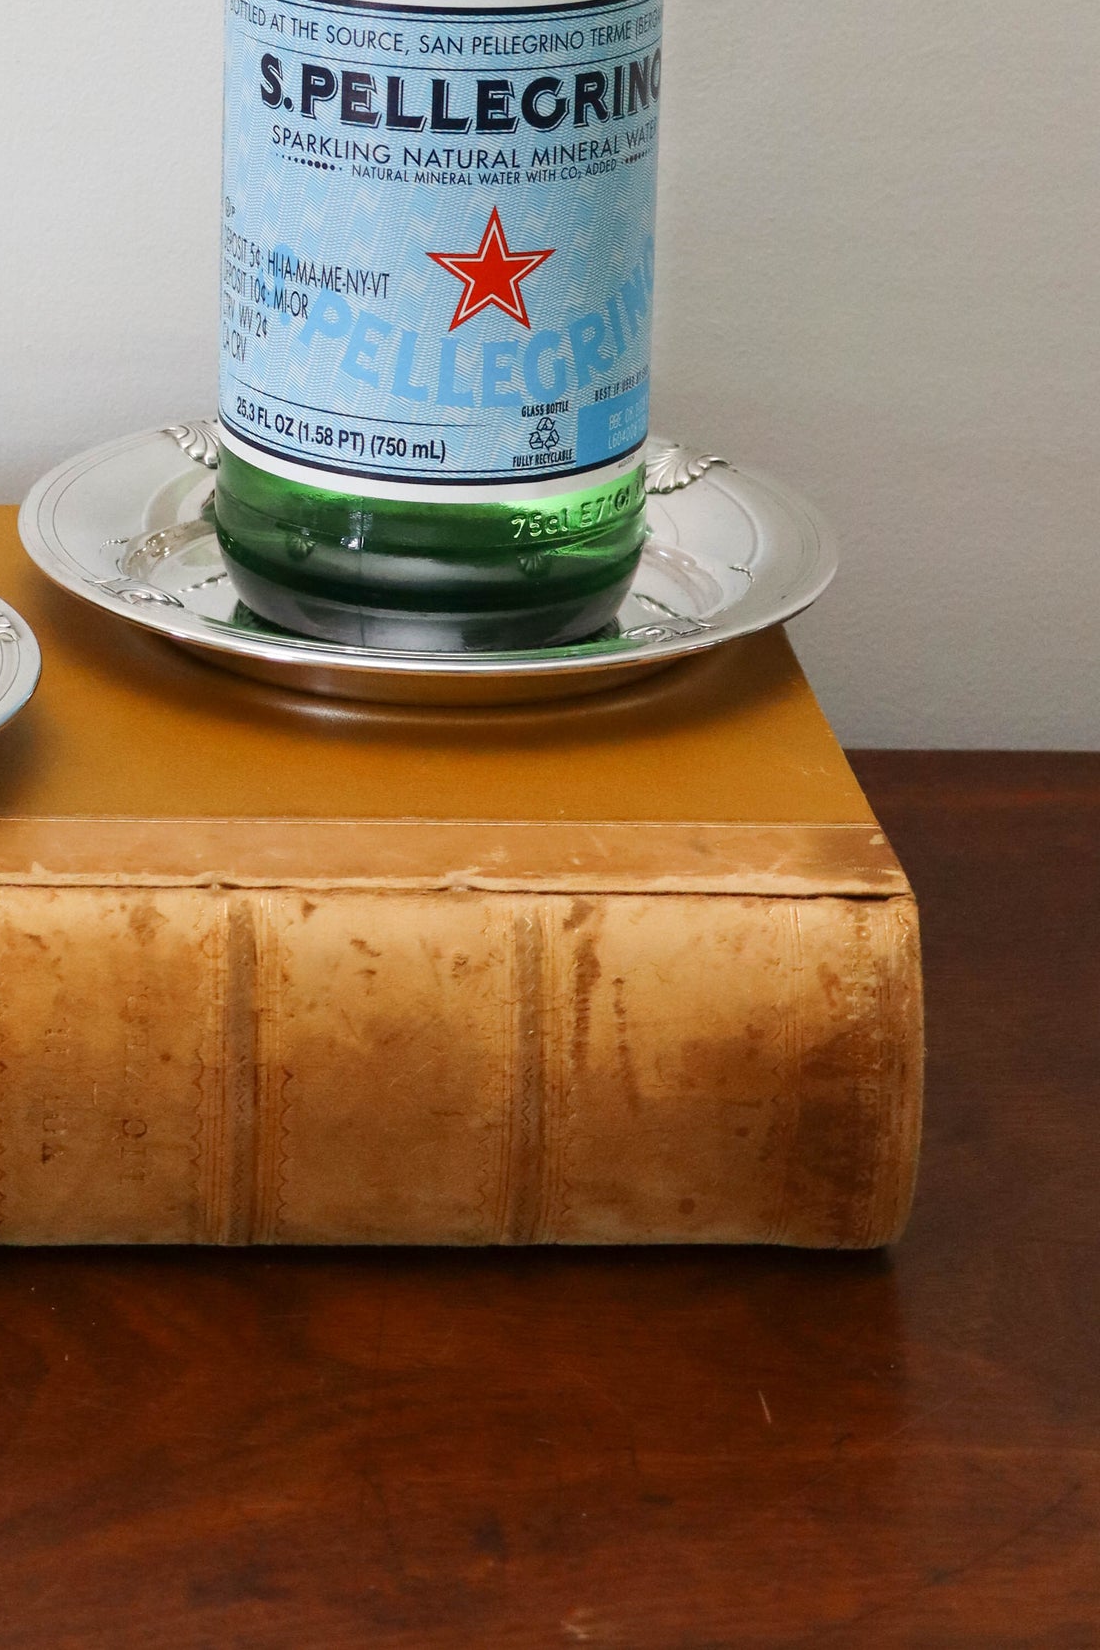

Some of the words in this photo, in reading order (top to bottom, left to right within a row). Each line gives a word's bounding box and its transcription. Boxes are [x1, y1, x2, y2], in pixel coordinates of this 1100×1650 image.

[270, 14, 286, 34] AT
[291, 17, 319, 41] THE
[326, 25, 410, 56] SOURCE,
[419, 35, 463, 55] SAN
[472, 31, 584, 55] PELLEGRINO
[591, 19, 631, 47] TERME
[272, 125, 391, 164] SPARKLING
[403, 147, 520, 169] NATURAL
[531, 135, 620, 167] MINERAL
[352, 165, 408, 182] NATURAL
[414, 172, 472, 185] MINERAL
[478, 171, 520, 185] WATER
[526, 168, 556, 183] WITH
[585, 158, 617, 177] ADDED
[267, 250, 390, 299] HI-IA-MA-ME-NY-VT
[273, 285, 309, 319] MI-OR
[522, 403, 545, 417] GLASS
[546, 400, 569, 415] BOTTLE
[236, 396, 255, 422] 25.3
[257, 407, 271, 429] FL
[274, 413, 294, 437] OZ
[298, 420, 334, 447] (1.58
[338, 430, 365, 456] PT)
[370, 435, 407, 458] (750
[412, 439, 446, 464] mL)
[512, 454, 534, 467] FULLY
[534, 448, 573, 466] RECYCLABLE
